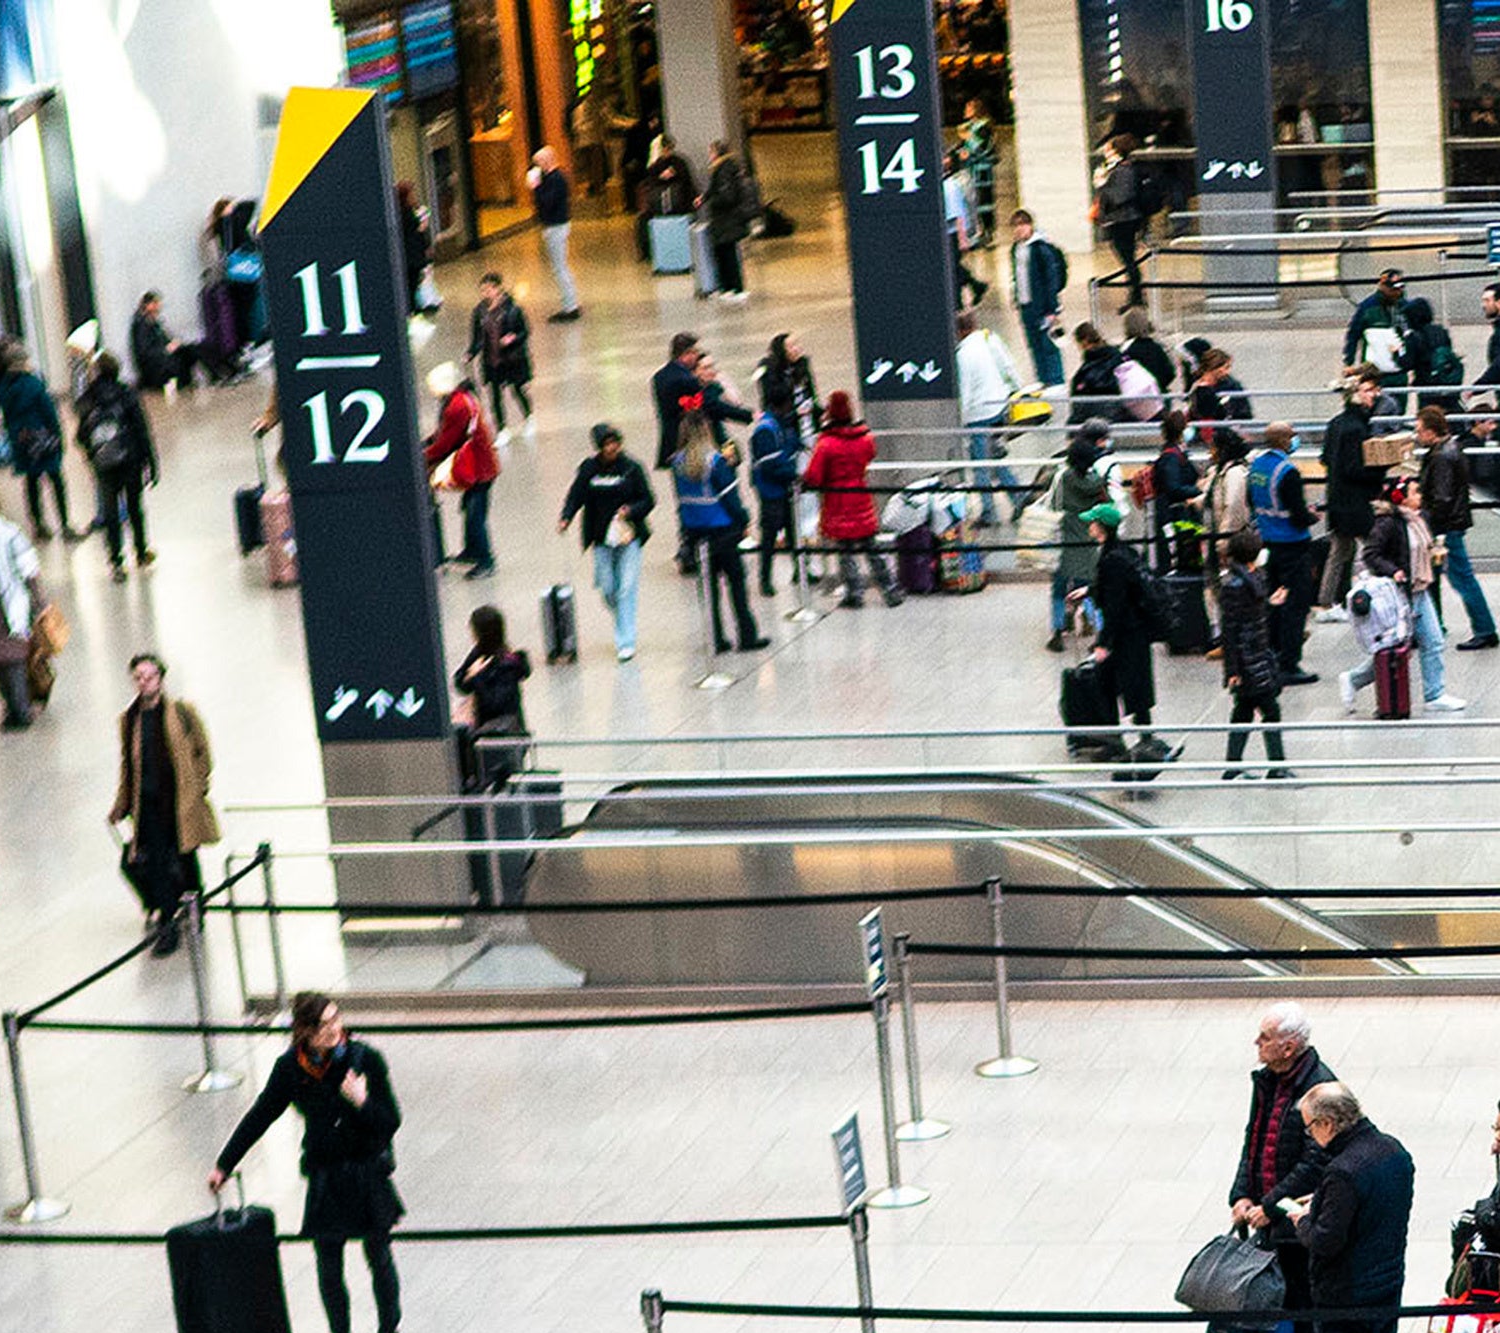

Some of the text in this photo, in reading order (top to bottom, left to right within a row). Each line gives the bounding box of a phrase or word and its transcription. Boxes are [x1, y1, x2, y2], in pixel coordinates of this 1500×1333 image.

[1205, 0, 1254, 32] 16
[853, 43, 916, 99] 13
[857, 138, 926, 195] 14
[293, 260, 367, 337] 11
[303, 389, 390, 464] 12
